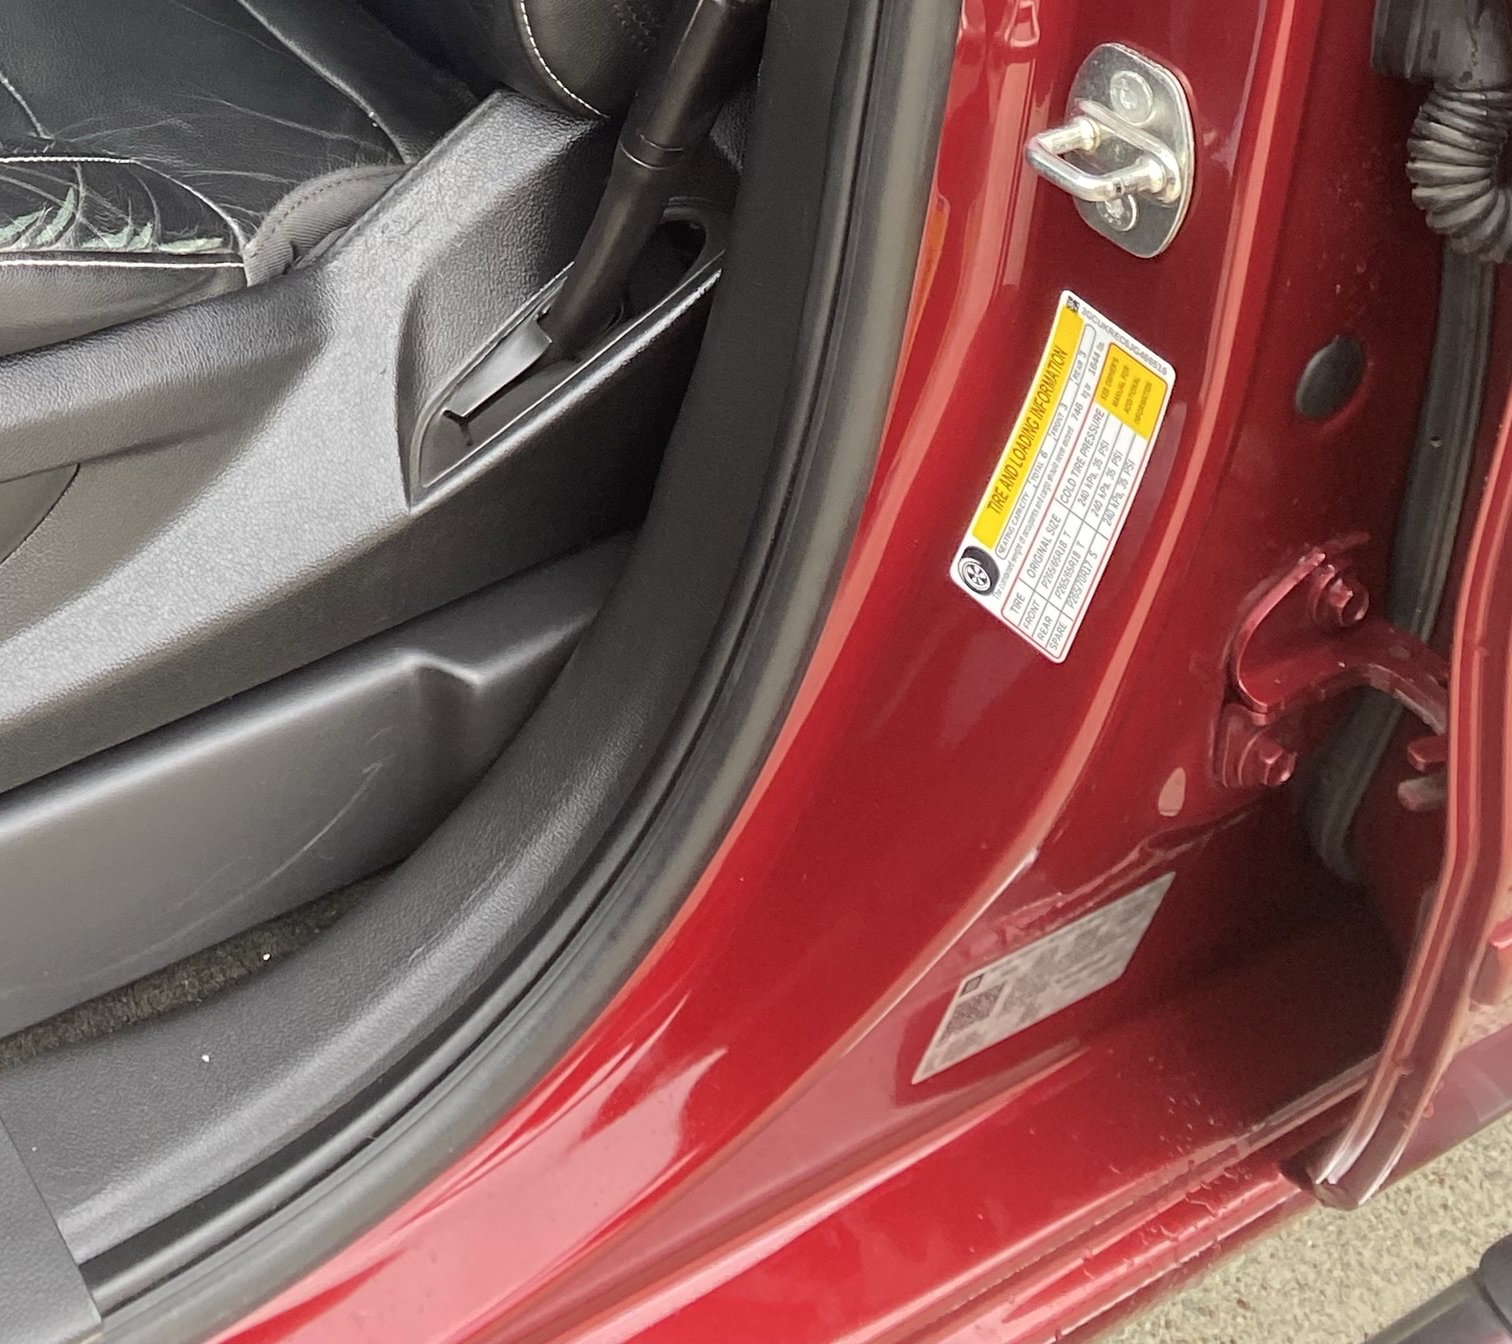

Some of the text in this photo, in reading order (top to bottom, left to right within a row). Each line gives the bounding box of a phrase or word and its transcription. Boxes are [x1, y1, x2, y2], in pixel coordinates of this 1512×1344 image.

[1072, 359, 1084, 380] REAR
[1087, 351, 1101, 375] 1644
[987, 344, 1068, 517] TIRE AND LOADING INFORMATION
[1050, 411, 1063, 436] FRONT
[1031, 459, 1043, 482] TOTAL
[1059, 407, 1104, 505] COLD TIRE PRESSURE
[1077, 488, 1089, 507] 240
[1092, 456, 1102, 470] 35
[1097, 439, 1109, 456] PSI
[1090, 498, 1103, 517] 240
[1105, 466, 1115, 480] 35
[1110, 449, 1122, 467] PSI
[1103, 508, 1115, 527] 240
[1118, 476, 1128, 490] 35
[1123, 458, 1135, 476] PSI
[998, 490, 1030, 557] SEATING CAPACITY
[1026, 512, 1061, 581] ORIGINAL SIZE
[1010, 591, 1024, 615] TIRE
[1023, 598, 1040, 631] FRONT
[1037, 614, 1052, 641] REAR
[1049, 620, 1066, 652] SPARE
